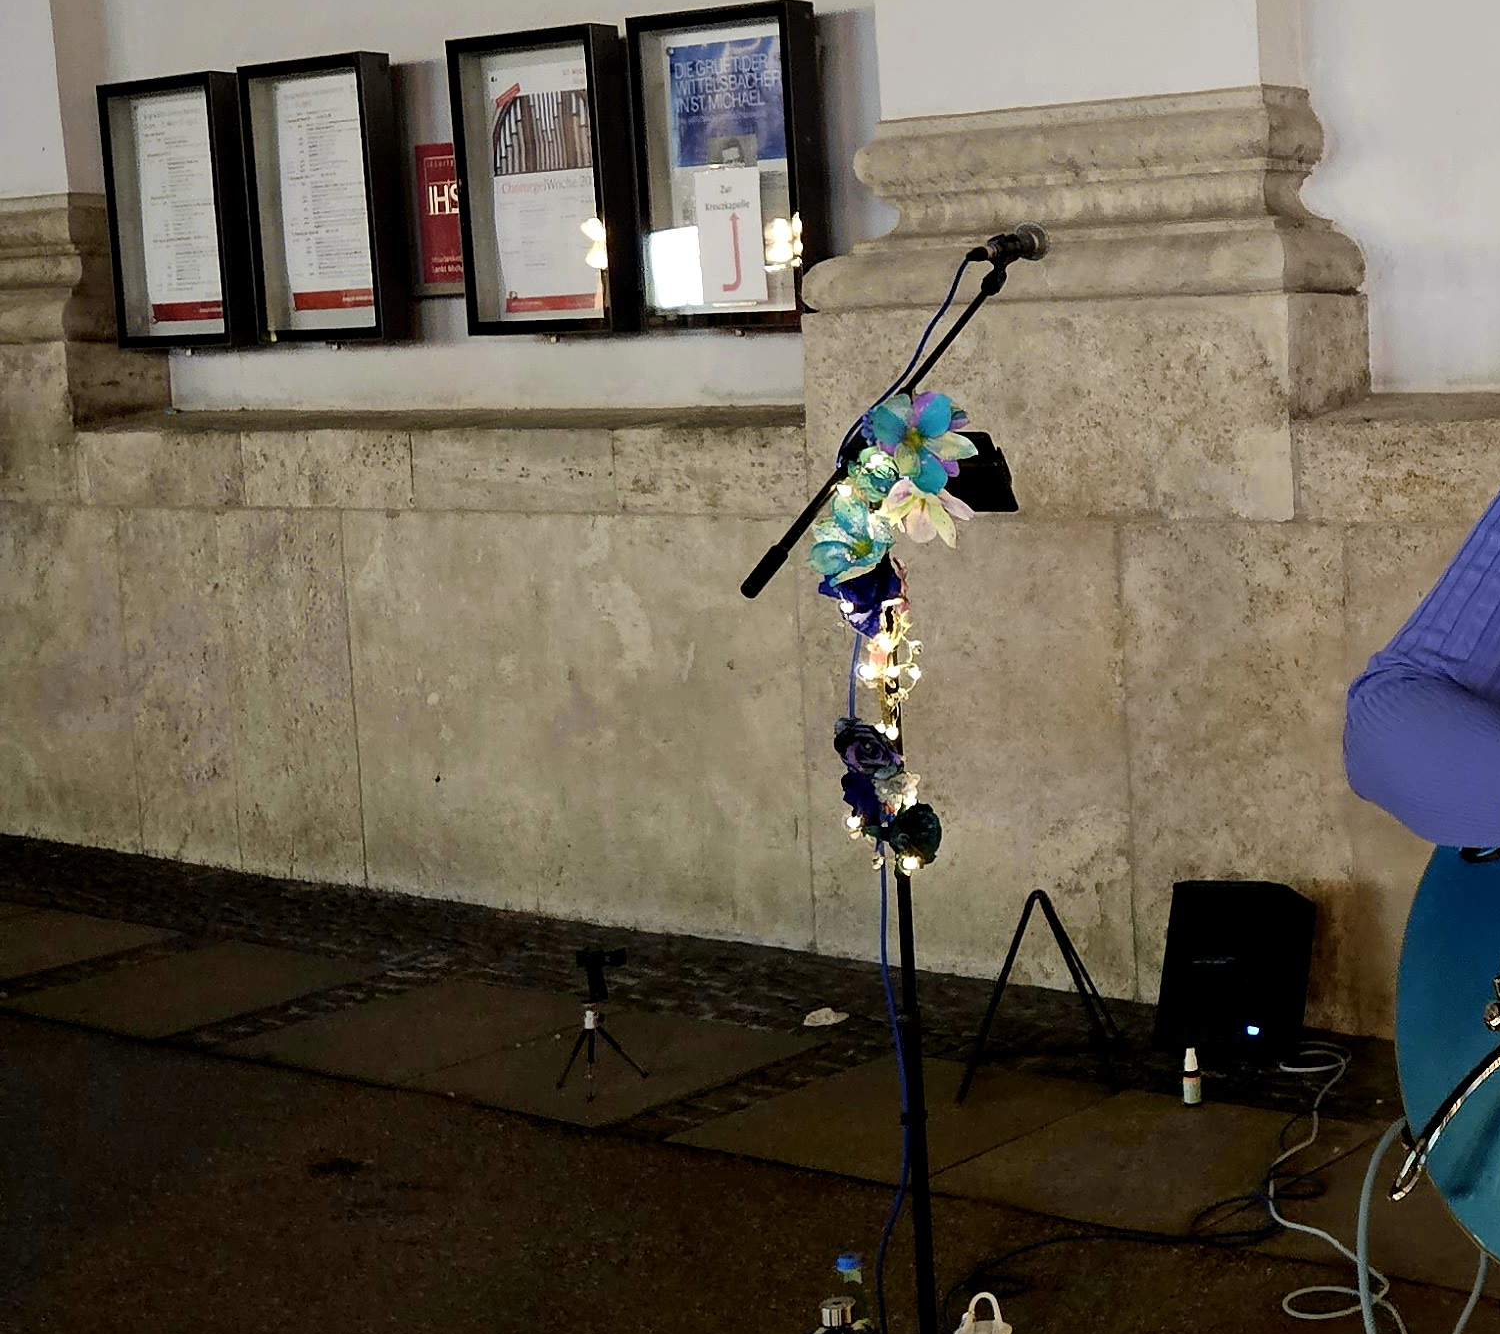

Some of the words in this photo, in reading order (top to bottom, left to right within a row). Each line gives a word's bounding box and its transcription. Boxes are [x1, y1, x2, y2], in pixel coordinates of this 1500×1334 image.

[674, 62, 694, 79] DIE
[675, 70, 781, 95] WITTELSBACHER
[708, 90, 765, 109] MICHAEL
